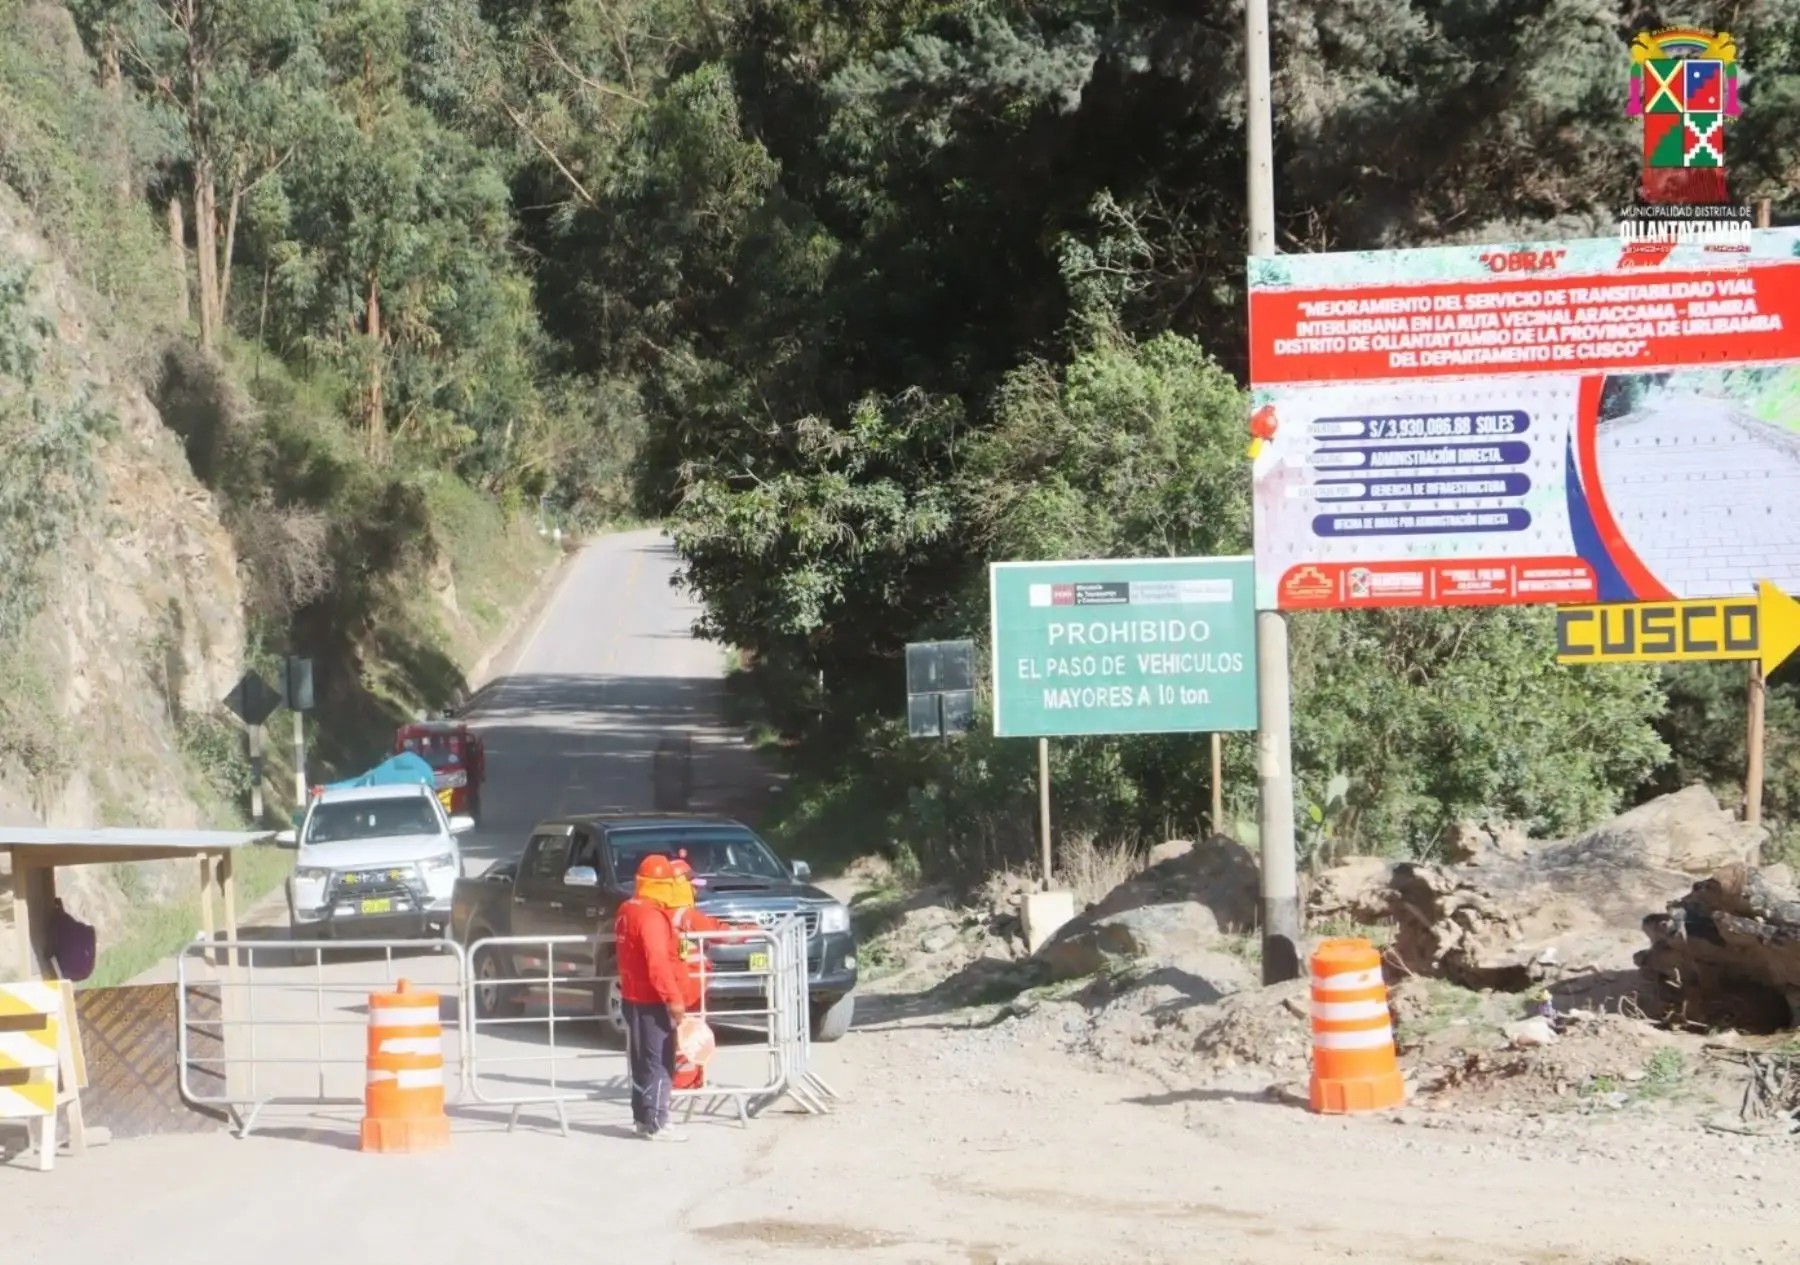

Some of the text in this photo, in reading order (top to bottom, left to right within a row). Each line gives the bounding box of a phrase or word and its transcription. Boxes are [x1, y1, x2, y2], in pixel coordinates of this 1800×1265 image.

[1435, 295, 1463, 311] DEL
[1465, 291, 1541, 309] SERVICIO
[1544, 291, 1566, 305] DE
[1569, 280, 1714, 303] TRANSITABILIDAD
[1717, 279, 1757, 295] VIAL
[1297, 316, 1409, 337] INTERURBANA
[1412, 316, 1432, 332] EN
[1435, 315, 1455, 330] LA
[1458, 313, 1499, 329] RUTA
[1501, 308, 1573, 327] VECINAL
[1575, 303, 1676, 323] ARACCAMA
[1274, 315, 1782, 355] DISTRITO DE OLLANTAYTAMBO DE LA PROVINCIA DE URUBAMBA
[1389, 351, 1418, 368] DEL
[1421, 345, 1551, 366] DEPARTAMENTO
[1552, 345, 1576, 360] DE
[1475, 415, 1515, 434] SOLES
[1370, 446, 1457, 467] ADMINISTRACIÓN
[1048, 620, 1210, 645] PROHIBIDO
[1557, 605, 1759, 655] CUSCO
[1018, 652, 1243, 679] EL PASO DE VEHICULOS
[1044, 686, 1132, 709] MAYORES
[1138, 686, 1150, 706] A
[1159, 684, 1174, 705] 10
